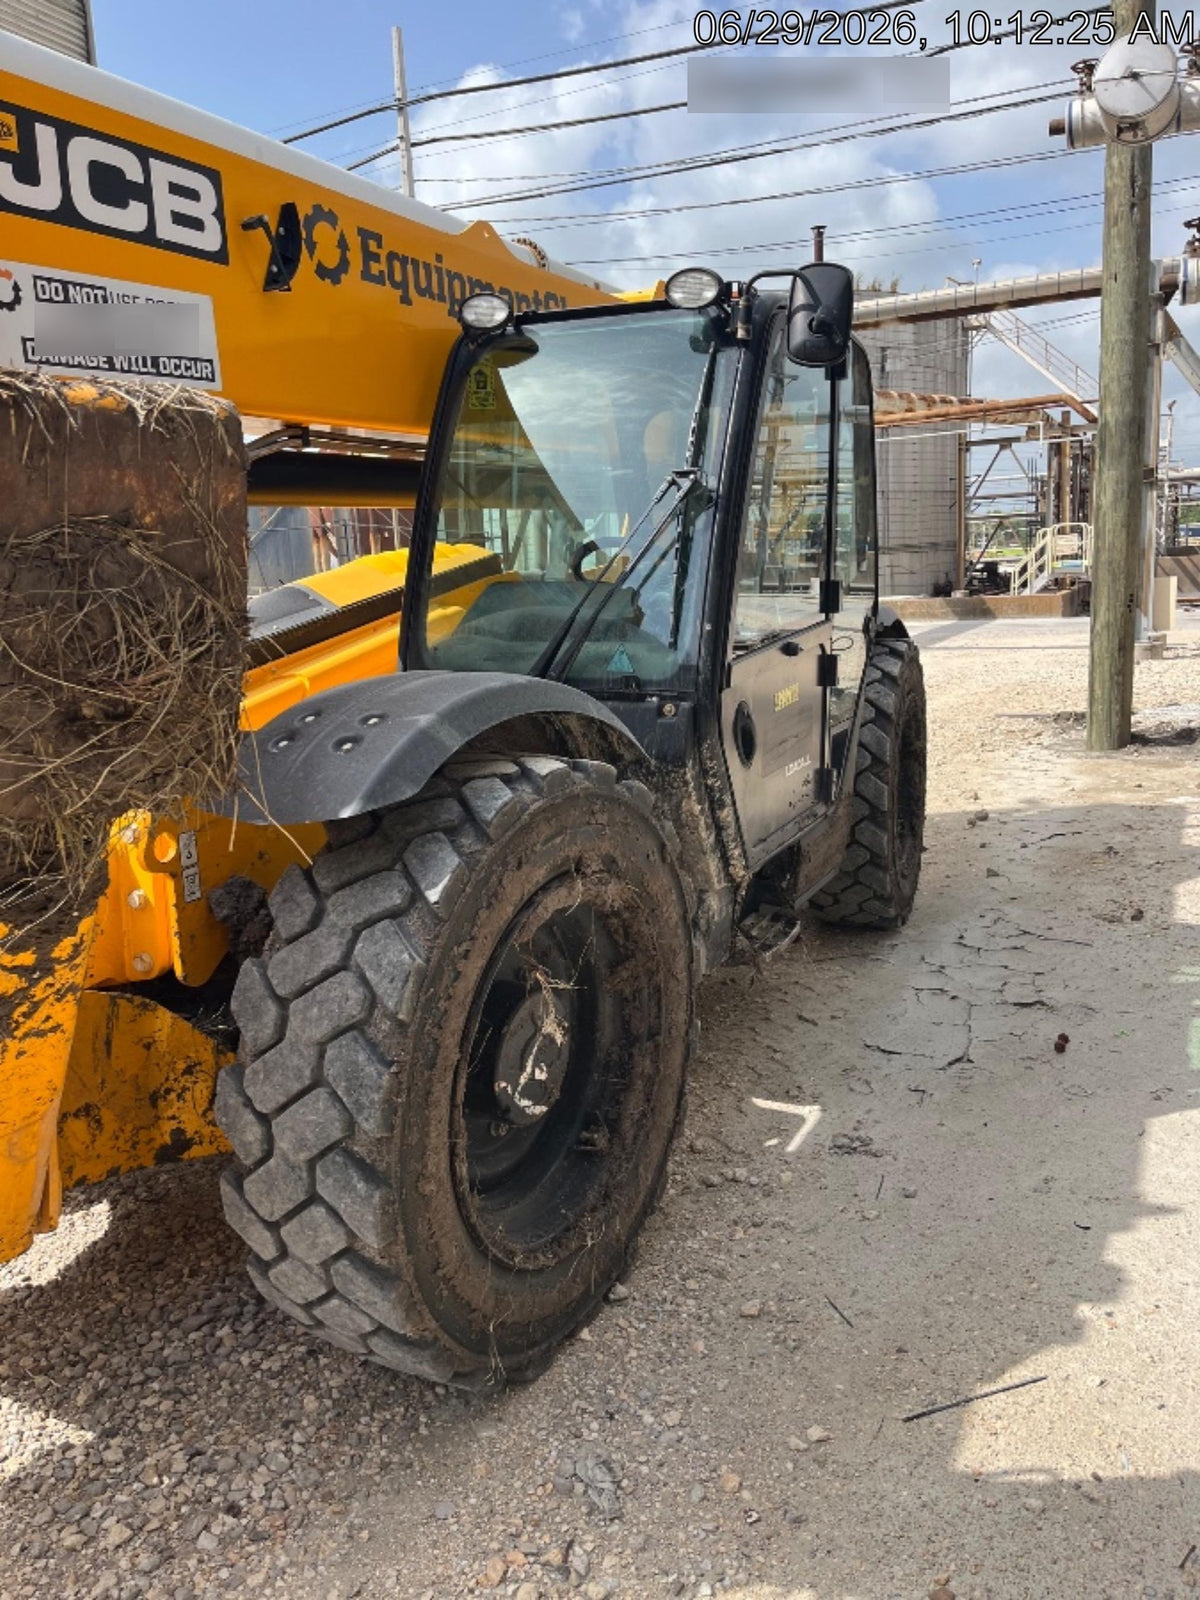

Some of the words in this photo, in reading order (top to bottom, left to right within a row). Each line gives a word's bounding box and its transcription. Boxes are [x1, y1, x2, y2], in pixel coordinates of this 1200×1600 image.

[0, 122, 222, 252] JCB
[36, 278, 64, 301] DO
[68, 286, 106, 304] NOT
[158, 357, 213, 379] OCCUR
